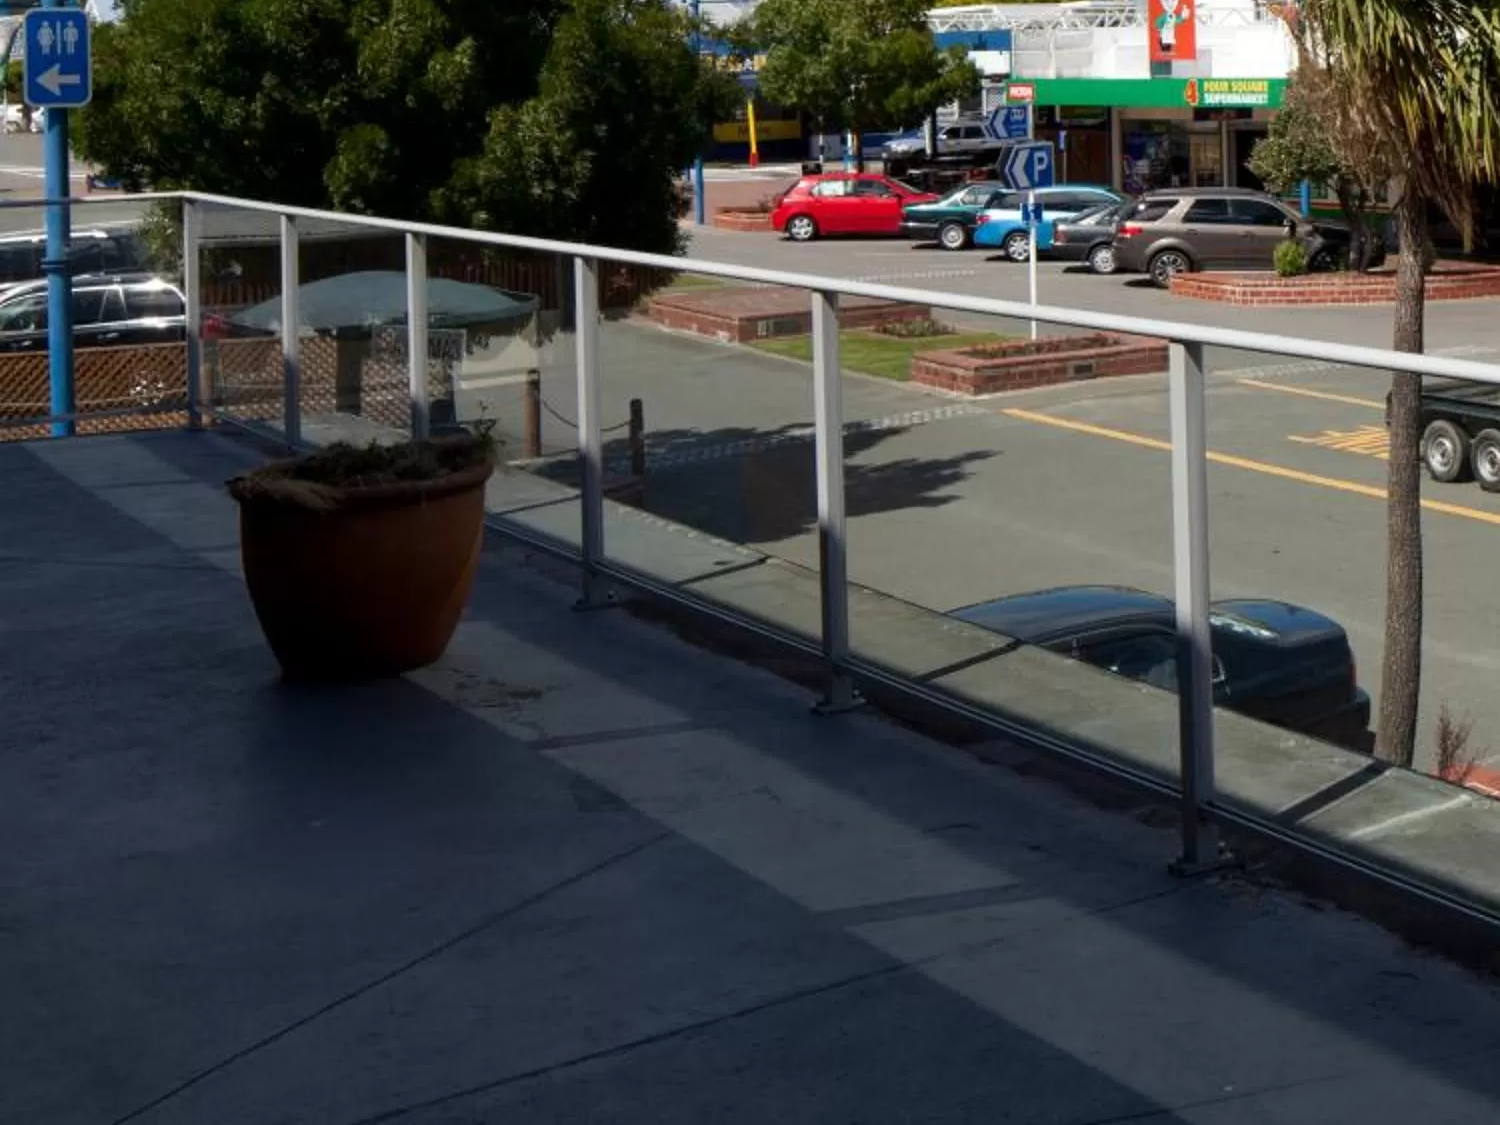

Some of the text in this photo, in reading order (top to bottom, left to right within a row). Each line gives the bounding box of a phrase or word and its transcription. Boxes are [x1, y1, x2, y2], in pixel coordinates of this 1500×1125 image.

[1184, 78, 1199, 106] 4
[1204, 80, 1269, 92] FOUR SQUARE
[1033, 150, 1048, 182] P
